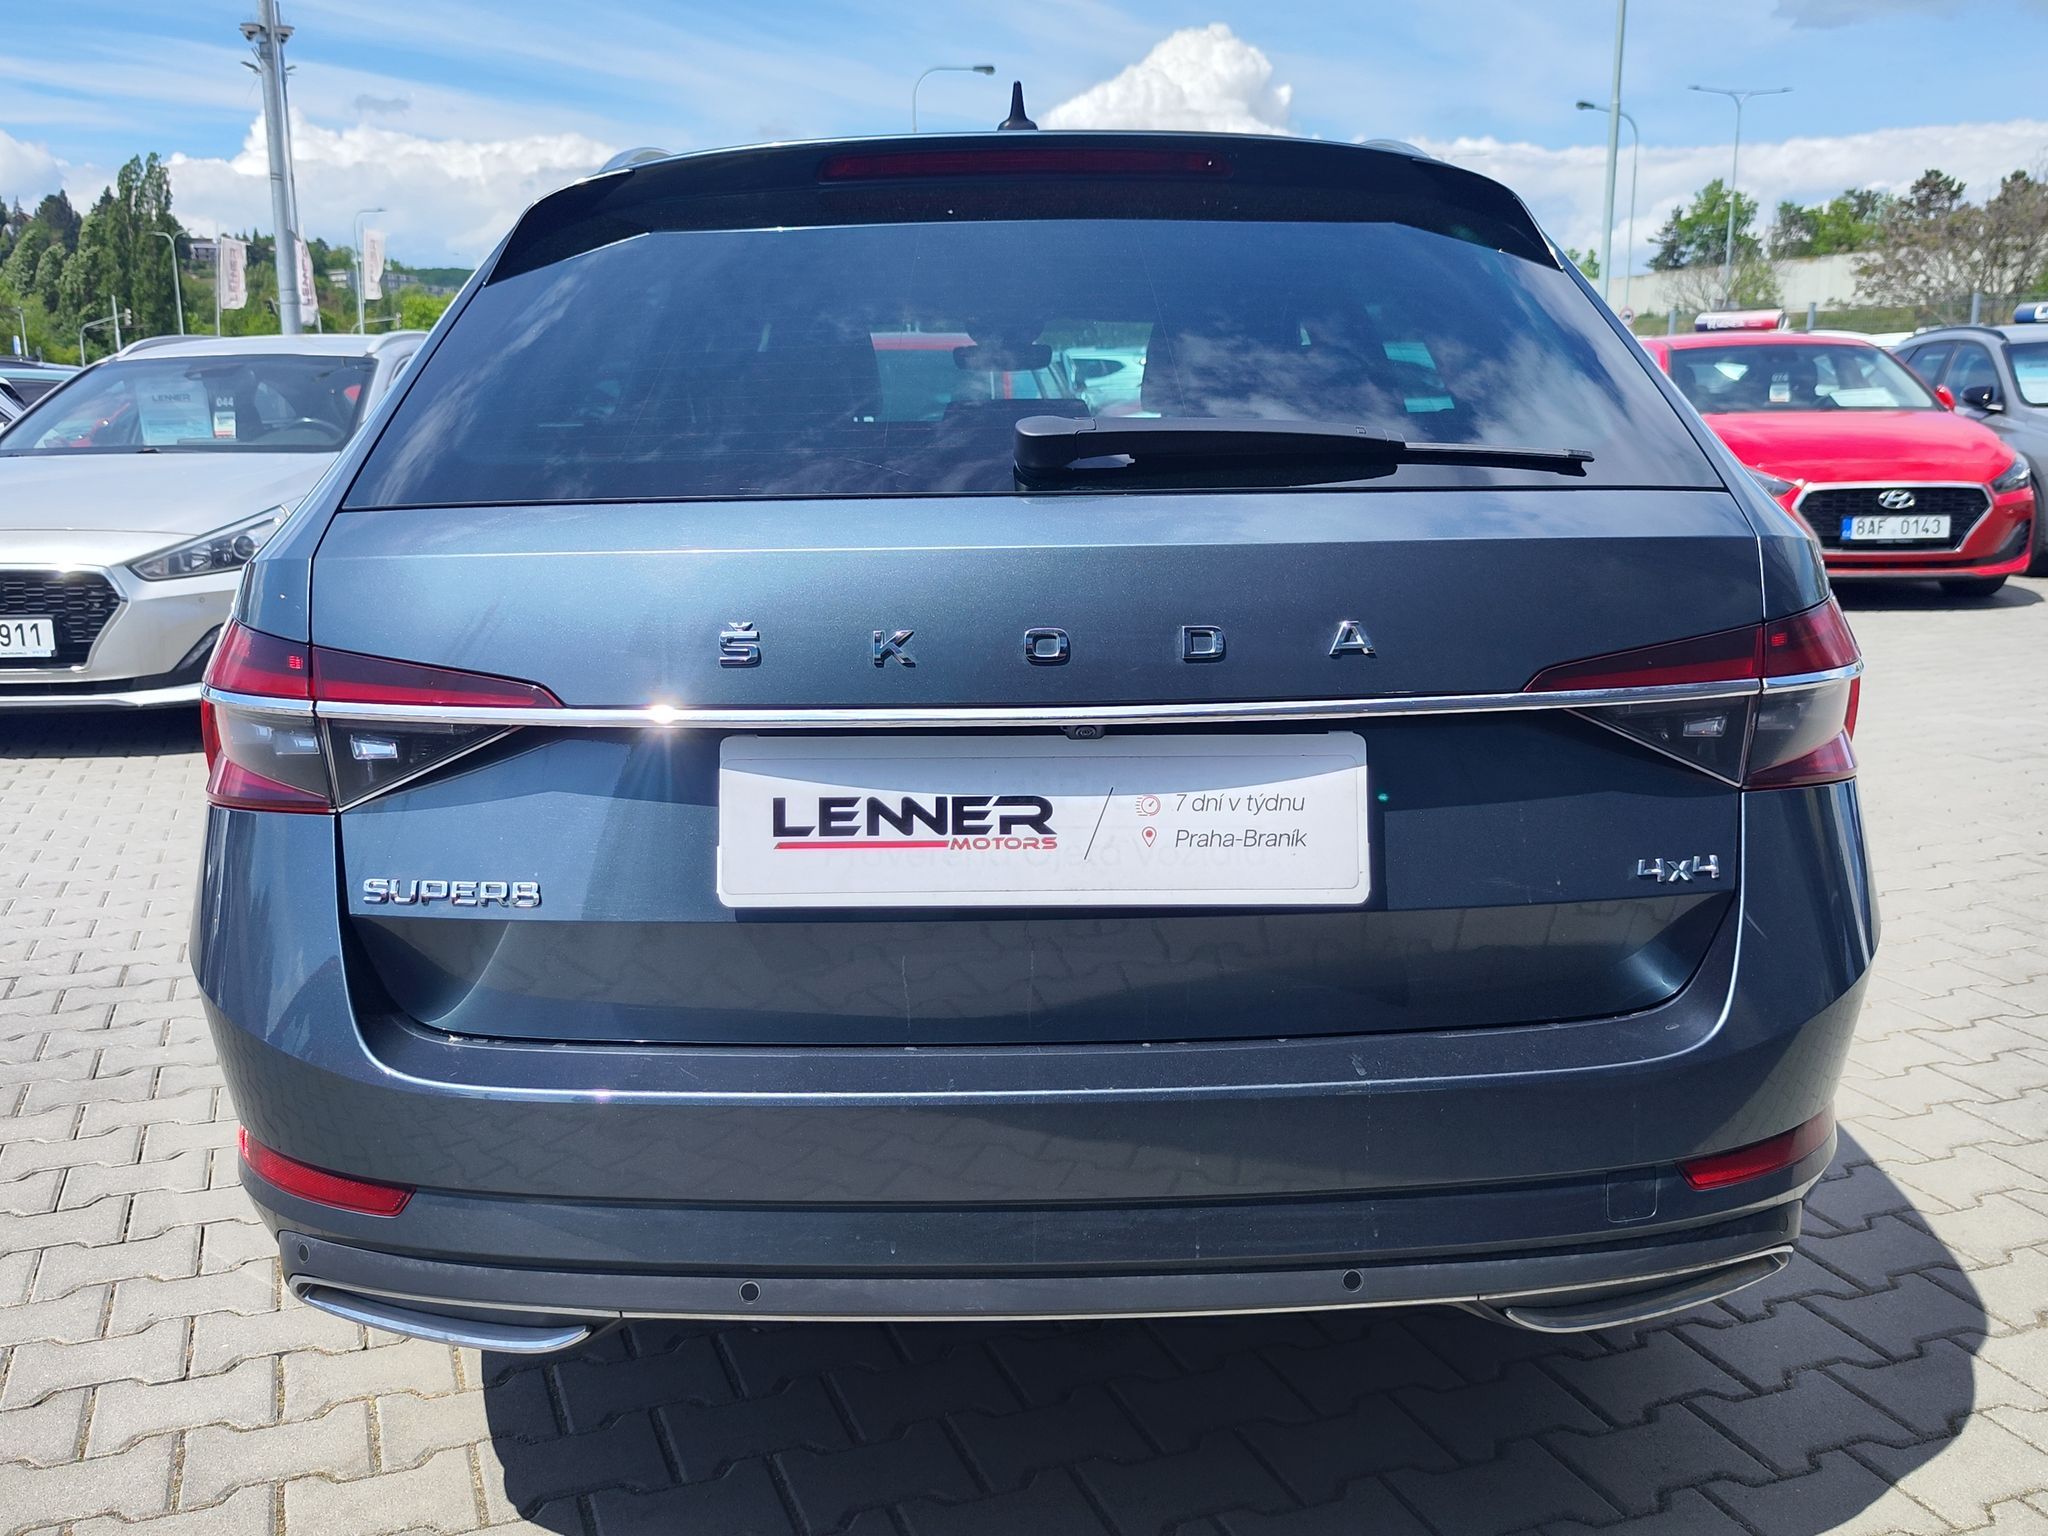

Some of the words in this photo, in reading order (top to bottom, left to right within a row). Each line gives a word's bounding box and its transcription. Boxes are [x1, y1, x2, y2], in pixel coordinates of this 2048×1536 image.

[1856, 519, 1886, 536] 8AF
[1900, 519, 1941, 535] 0143
[0, 623, 41, 647] 911
[719, 621, 1377, 668] ŠKODA
[1176, 794, 1188, 811] 7
[1192, 793, 1225, 811] dní
[1228, 799, 1241, 811] v
[1246, 793, 1305, 815] týdnu
[773, 796, 1057, 837] LENNER
[950, 837, 1058, 850] MOTORS
[1175, 829, 1308, 848] Praha-Braník
[363, 879, 541, 907] SUPERB
